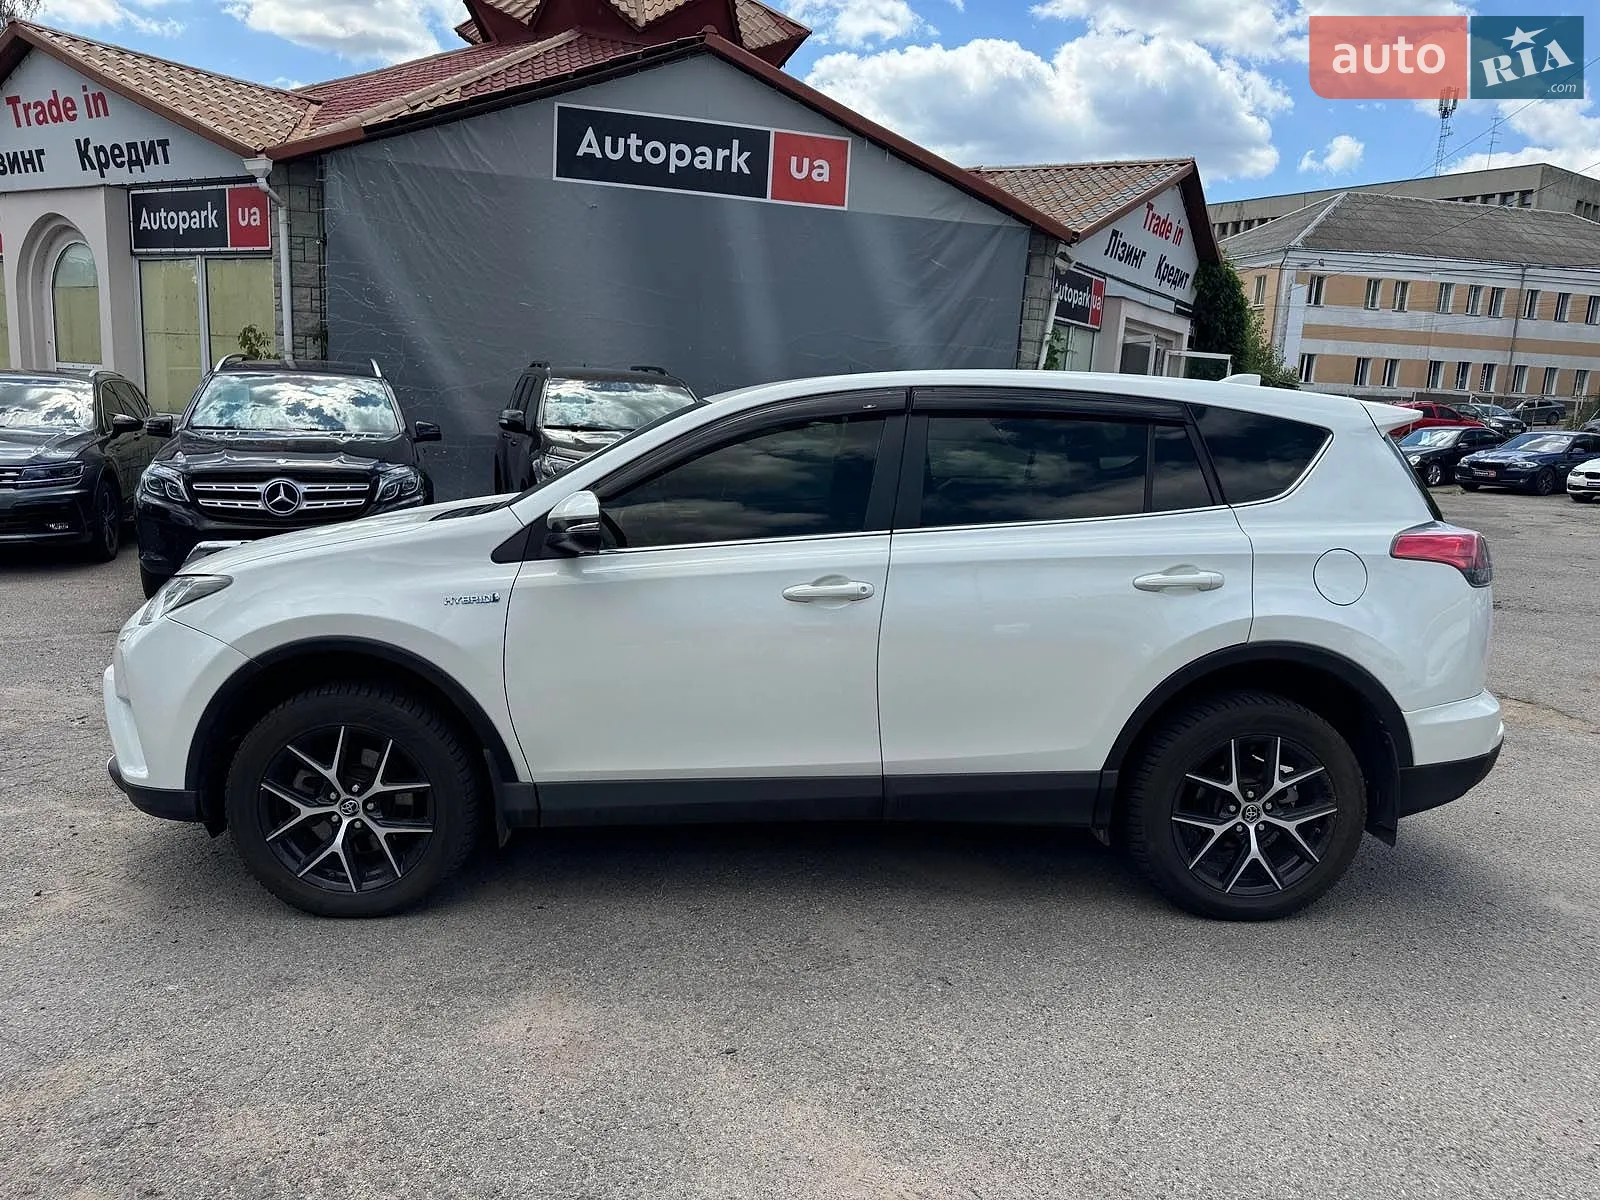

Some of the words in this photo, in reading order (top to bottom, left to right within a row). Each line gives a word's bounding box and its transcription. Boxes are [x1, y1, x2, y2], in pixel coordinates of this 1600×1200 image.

[6, 89, 78, 129] Trade
[82, 84, 110, 120] in
[75, 137, 170, 178] Кредит
[576, 126, 752, 175] Autopark
[790, 155, 831, 183] ua
[139, 201, 219, 235] Autopark
[238, 206, 261, 228] ua
[1143, 201, 1173, 241] Trade
[1172, 219, 1185, 247] in
[1104, 228, 1147, 270] Лізинг
[1154, 253, 1190, 291] Кредит
[1092, 295, 1102, 310] ua
[443, 594, 493, 606] HYBRID
